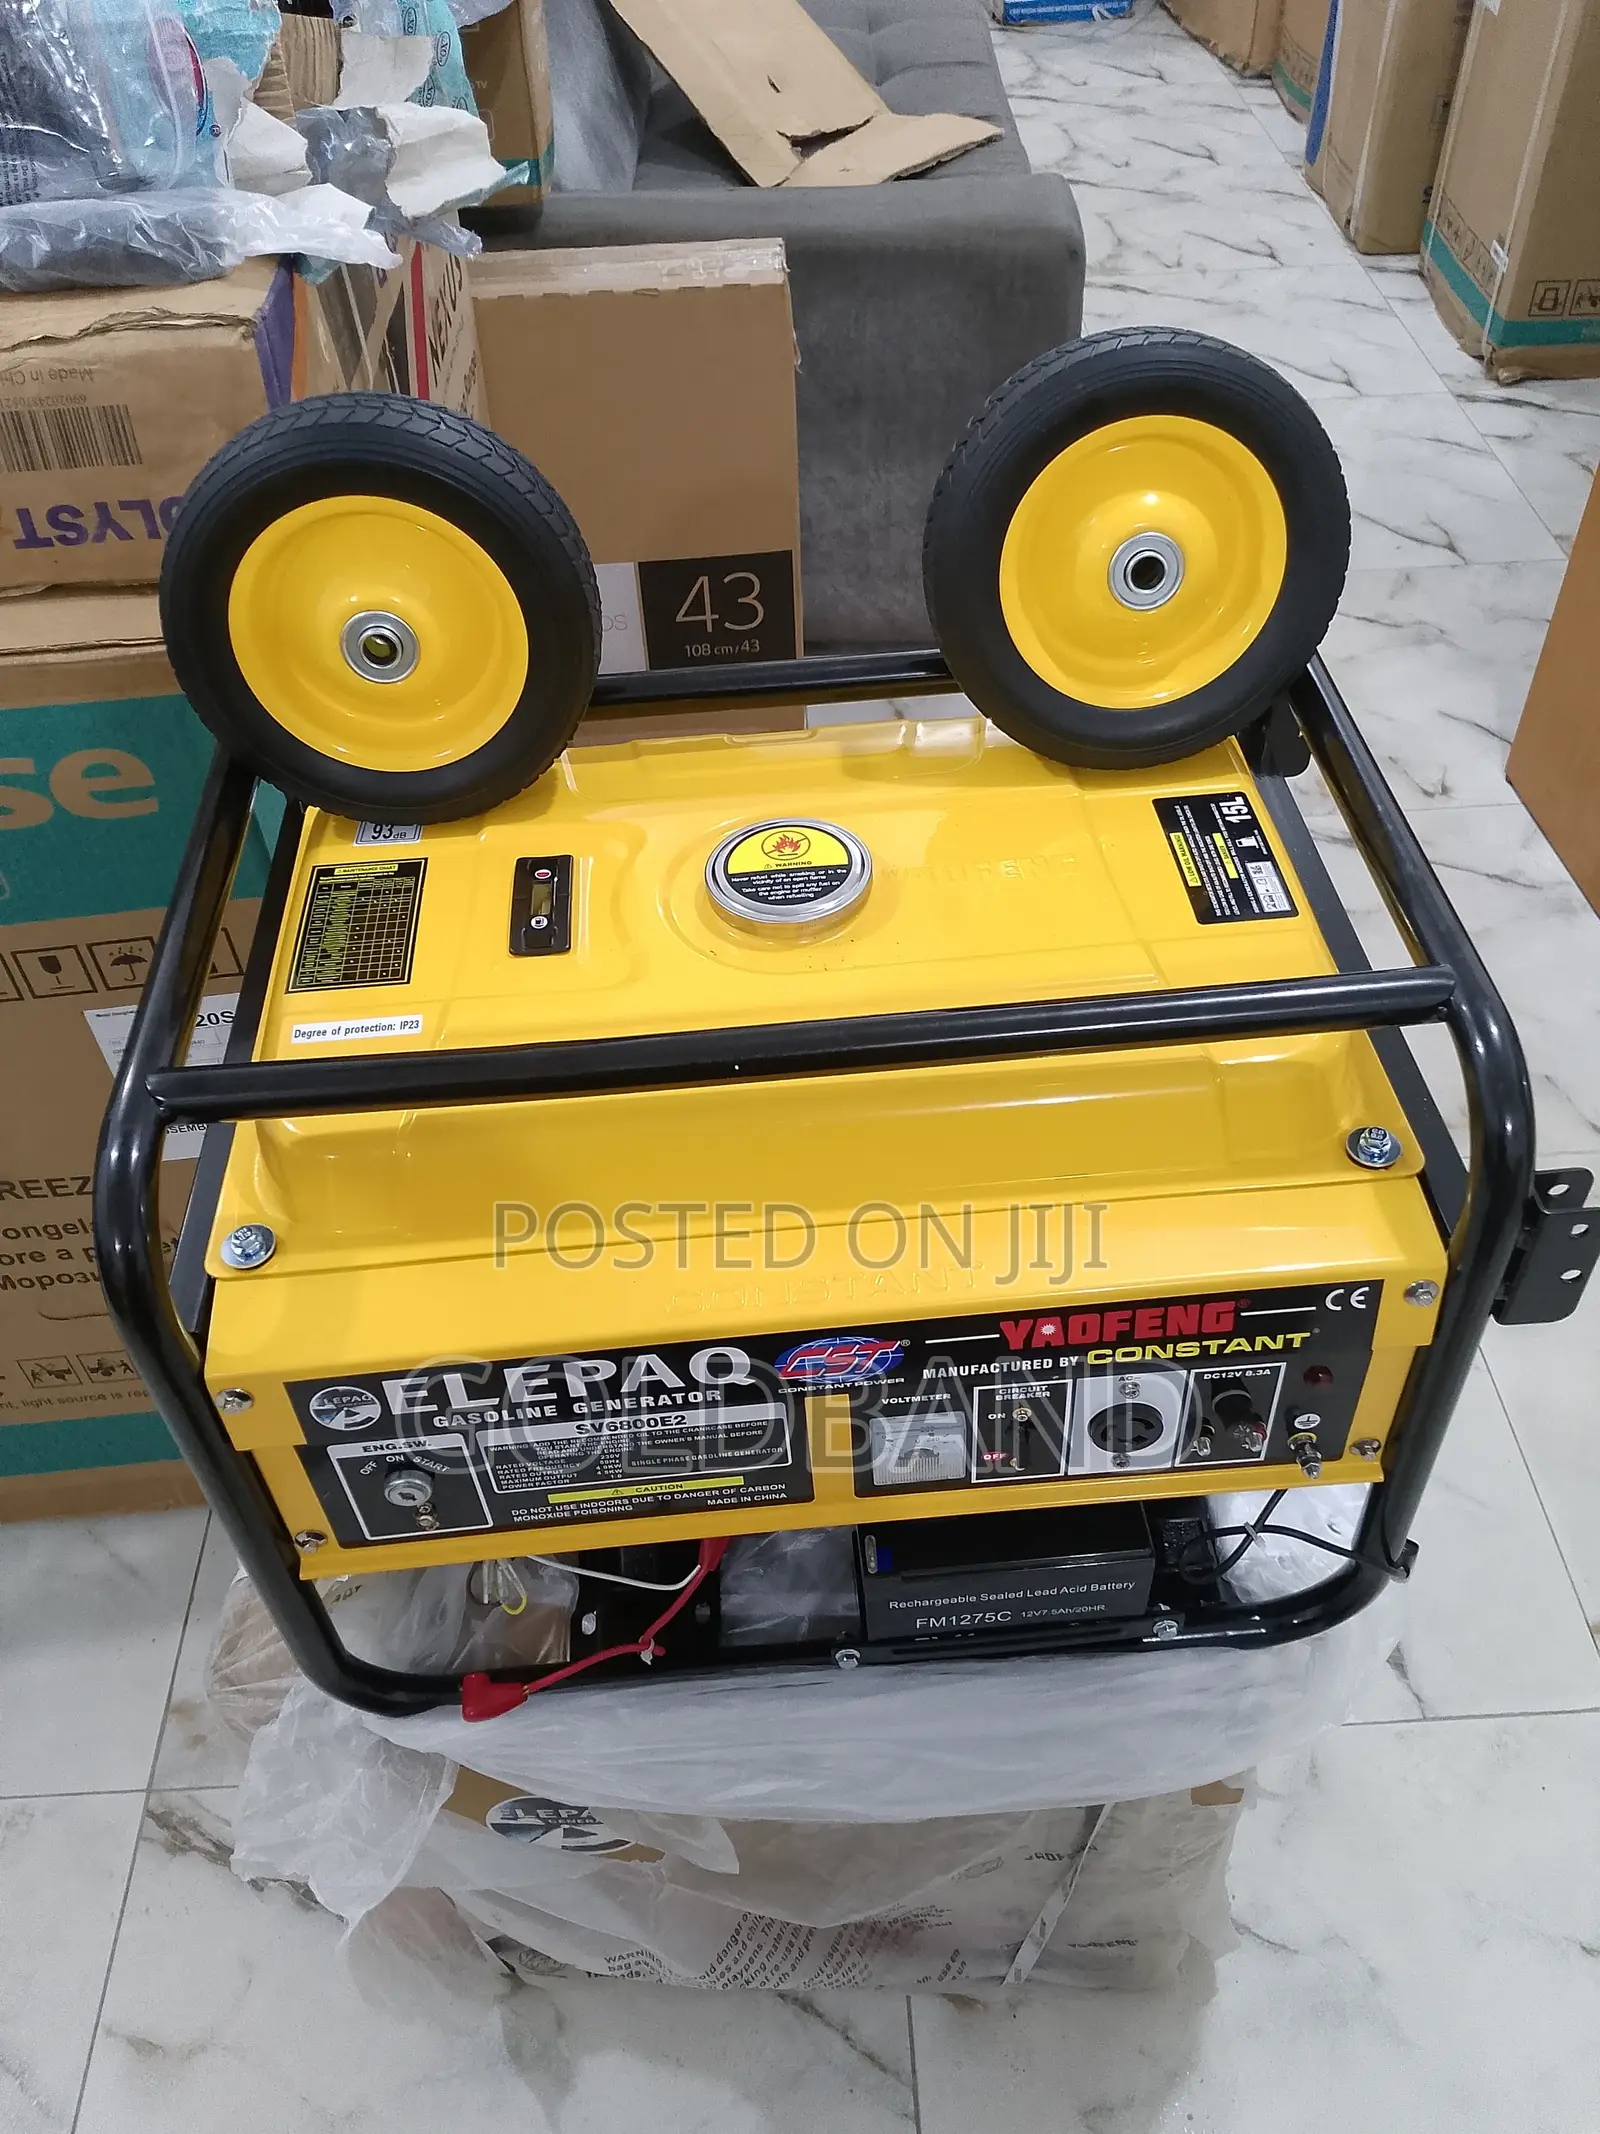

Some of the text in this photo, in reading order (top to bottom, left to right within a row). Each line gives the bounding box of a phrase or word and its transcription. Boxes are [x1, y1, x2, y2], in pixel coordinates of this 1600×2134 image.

[47, 367, 95, 382] Made
[675, 571, 764, 633] 43
[684, 643, 711, 658] 108
[1216, 795, 1253, 824] 15L
[294, 1019, 420, 1040] Degree of protection: IP23
[1325, 1286, 1371, 1311] CE
[1000, 1300, 1236, 1350] YAOFENG
[1086, 1332, 1311, 1365] CONSTANT
[922, 1355, 1079, 1380] MANUFACTURED BY
[1203, 1368, 1272, 1380] DC12V 8.3A
[381, 1350, 757, 1415] ELEPAQ
[778, 1378, 905, 1394] CONSTANT POWER
[998, 1385, 1049, 1395] CIRCUIT
[21, 1391, 123, 1409] light source is
[881, 1393, 952, 1405] VOLTMETER
[995, 1391, 1051, 1401] BREAKER
[432, 1390, 721, 1429] GASOLINE GENERATOR
[988, 1412, 1006, 1420] ON
[575, 1414, 687, 1436] SV6800E2
[570, 1433, 635, 1445] RECOMMENDED
[682, 1424, 733, 1433] CRANKCASE
[654, 1436, 692, 1445] OWNER'S
[694, 1433, 728, 1441] MANUAL
[362, 1440, 432, 1453] ENG.SW.
[691, 1451, 734, 1460] GASOLINE
[734, 1447, 783, 1456] GENERATOR
[386, 1454, 405, 1464] ON
[413, 1455, 451, 1474] START
[526, 1459, 566, 1467] VOLTAGE
[983, 1453, 1006, 1461] OFF
[360, 1460, 378, 1476] OFF
[529, 1469, 564, 1477] OUTPUT
[500, 1477, 543, 1485] MAXIMUM
[635, 1483, 684, 1493] CAUTION
[530, 1506, 553, 1514] NOT
[580, 1499, 629, 1509] INDOORS
[631, 1496, 655, 1504] DUE
[674, 1490, 720, 1499] DANGER
[739, 1484, 786, 1494] CARBON
[707, 1497, 738, 1506] MADE
[754, 1492, 788, 1501] CHINA
[513, 1505, 634, 1522] MONOXIDE POISONING
[889, 1579, 1136, 1610] Rechargeable Sealed Lead Acid Battery
[915, 1610, 1012, 1630] FM1275C
